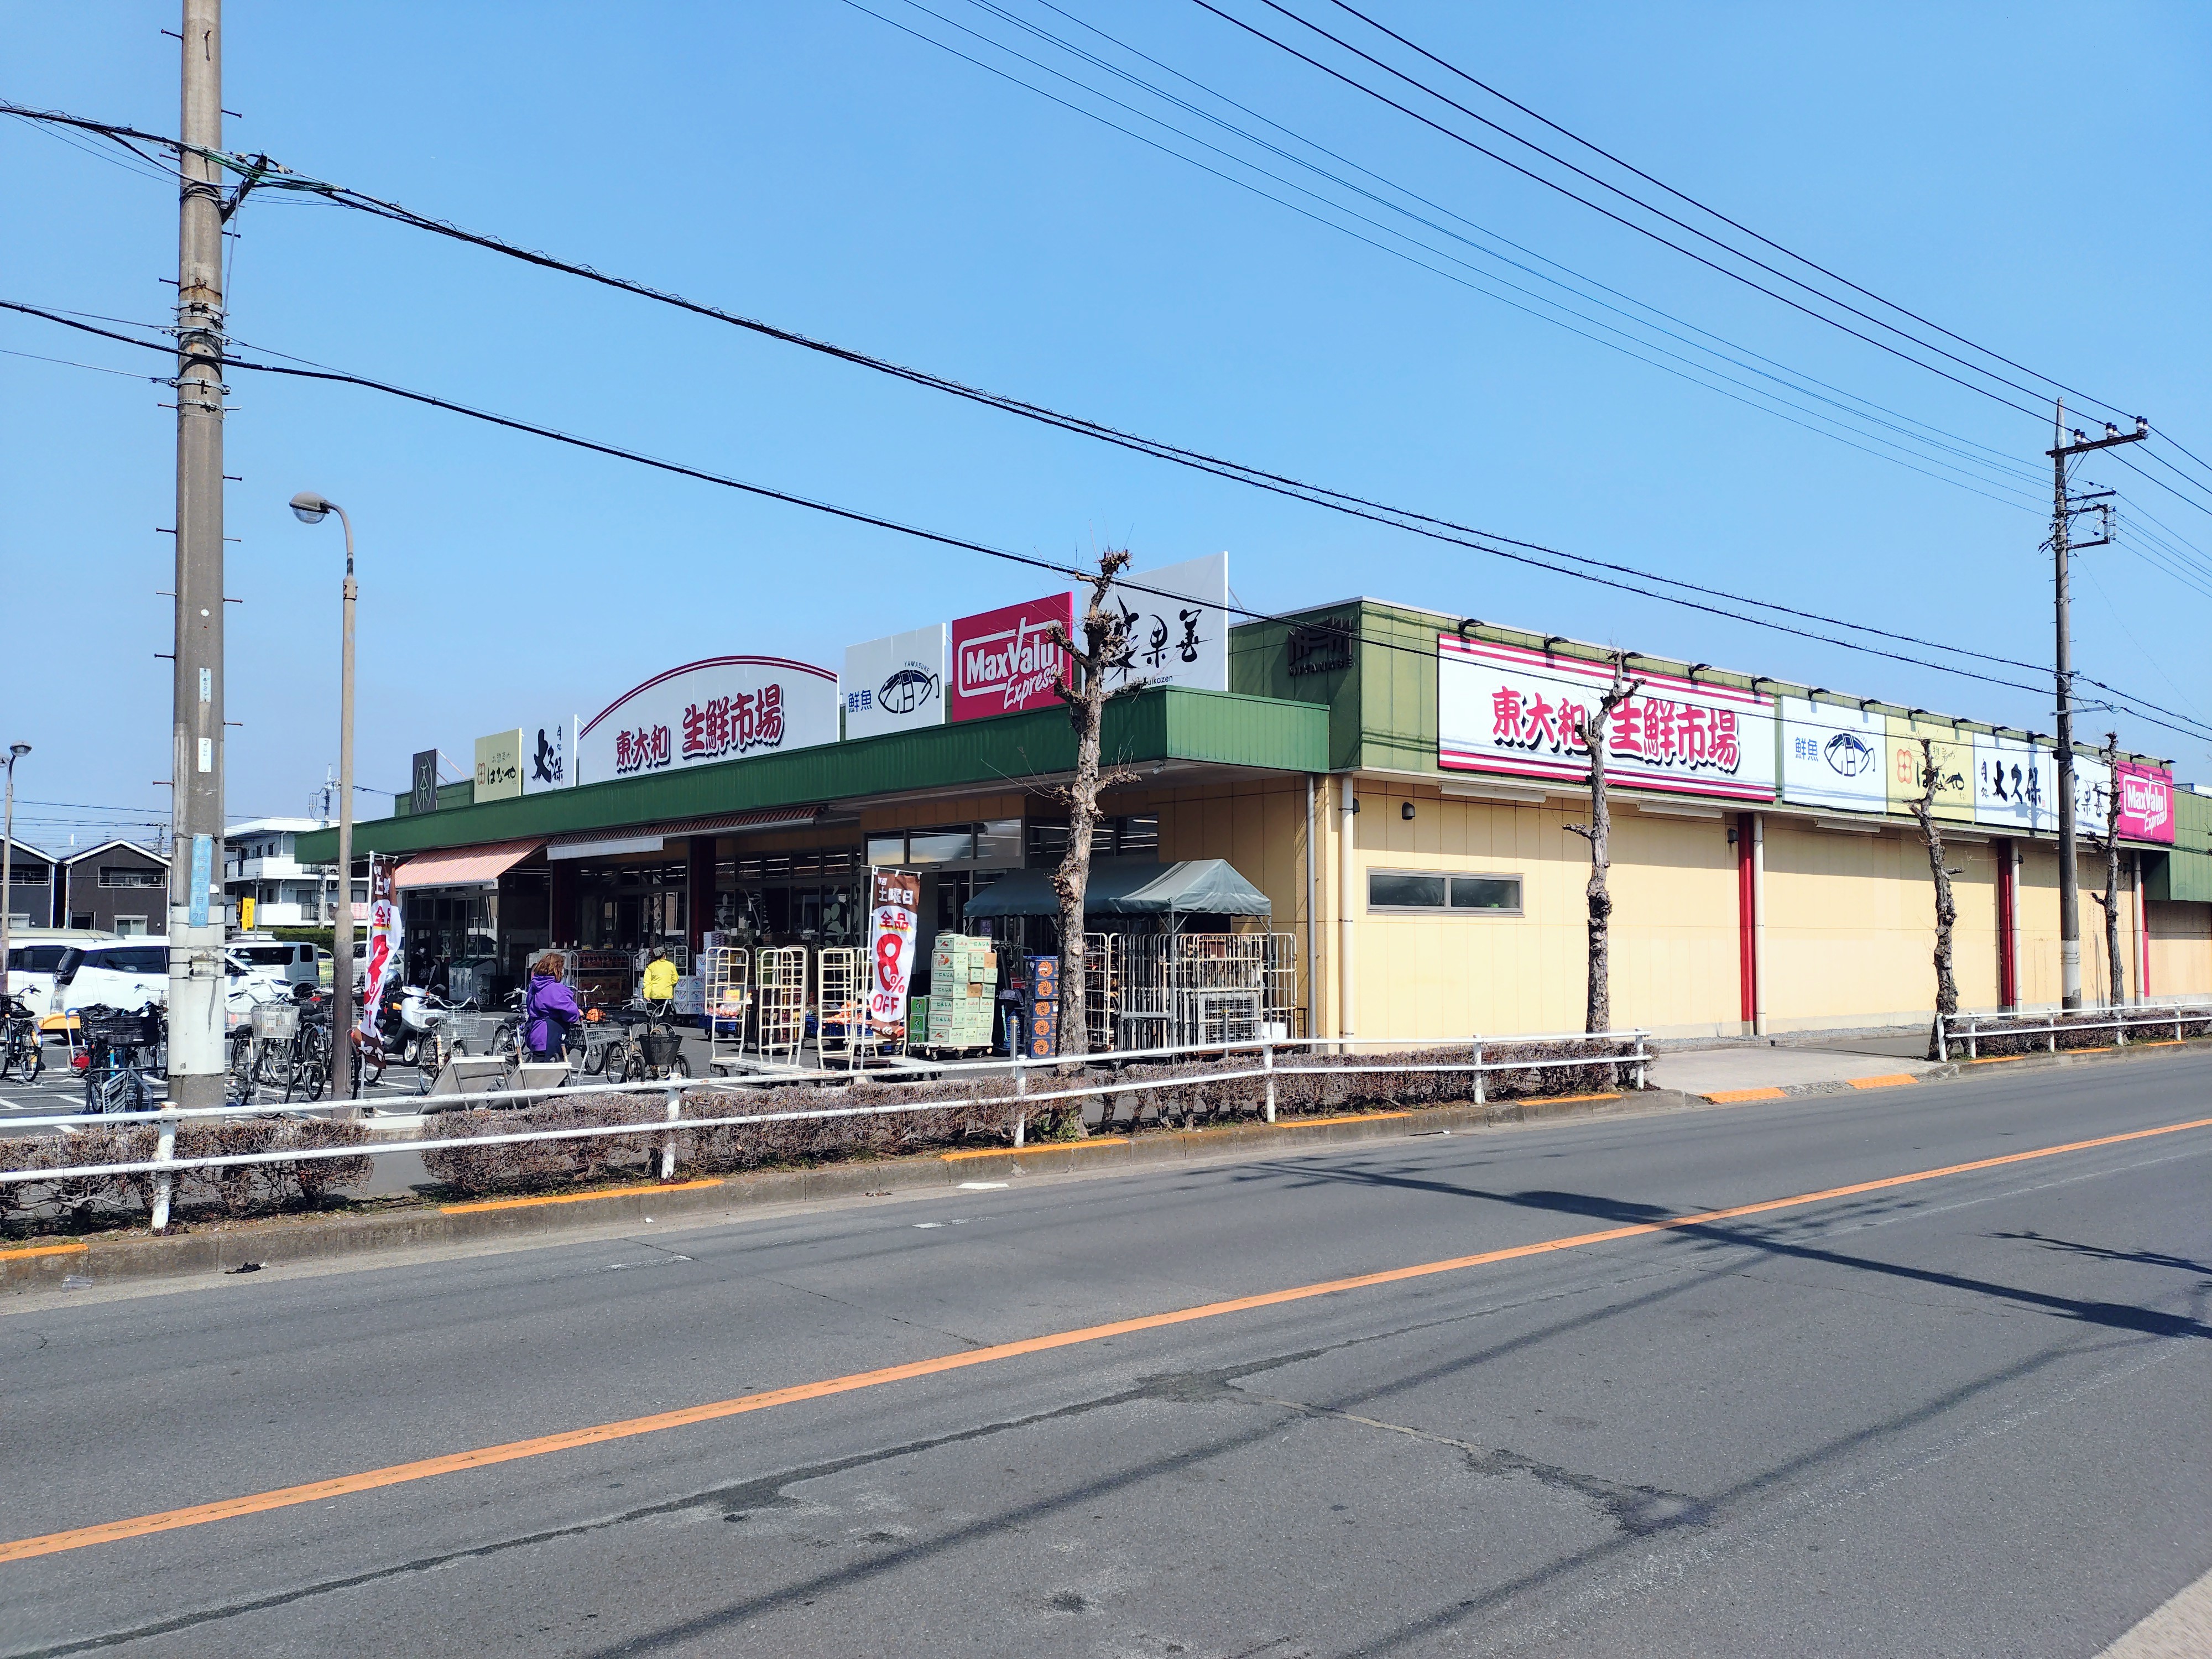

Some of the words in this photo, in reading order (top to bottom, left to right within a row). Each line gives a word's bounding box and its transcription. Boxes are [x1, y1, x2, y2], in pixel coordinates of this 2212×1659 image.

[966, 617, 1054, 685] MaxValu
[904, 661, 930, 674] YAMASUKE
[848, 690, 872, 713] 鮮魚
[615, 724, 669, 769] 東大和
[682, 684, 784, 754] 生鮮市場
[1492, 685, 1586, 747] 東大和
[1608, 697, 1738, 767] 生鮮市場
[1795, 736, 1819, 762] 鮮魚
[487, 765, 516, 785] はなや
[2127, 779, 2163, 812] MaxValu
[2144, 810, 2165, 836] Express
[878, 886, 914, 905] 土曜日
[192, 912, 206, 921] 20
[880, 910, 909, 930] 全品
[872, 993, 899, 1015] OFF
